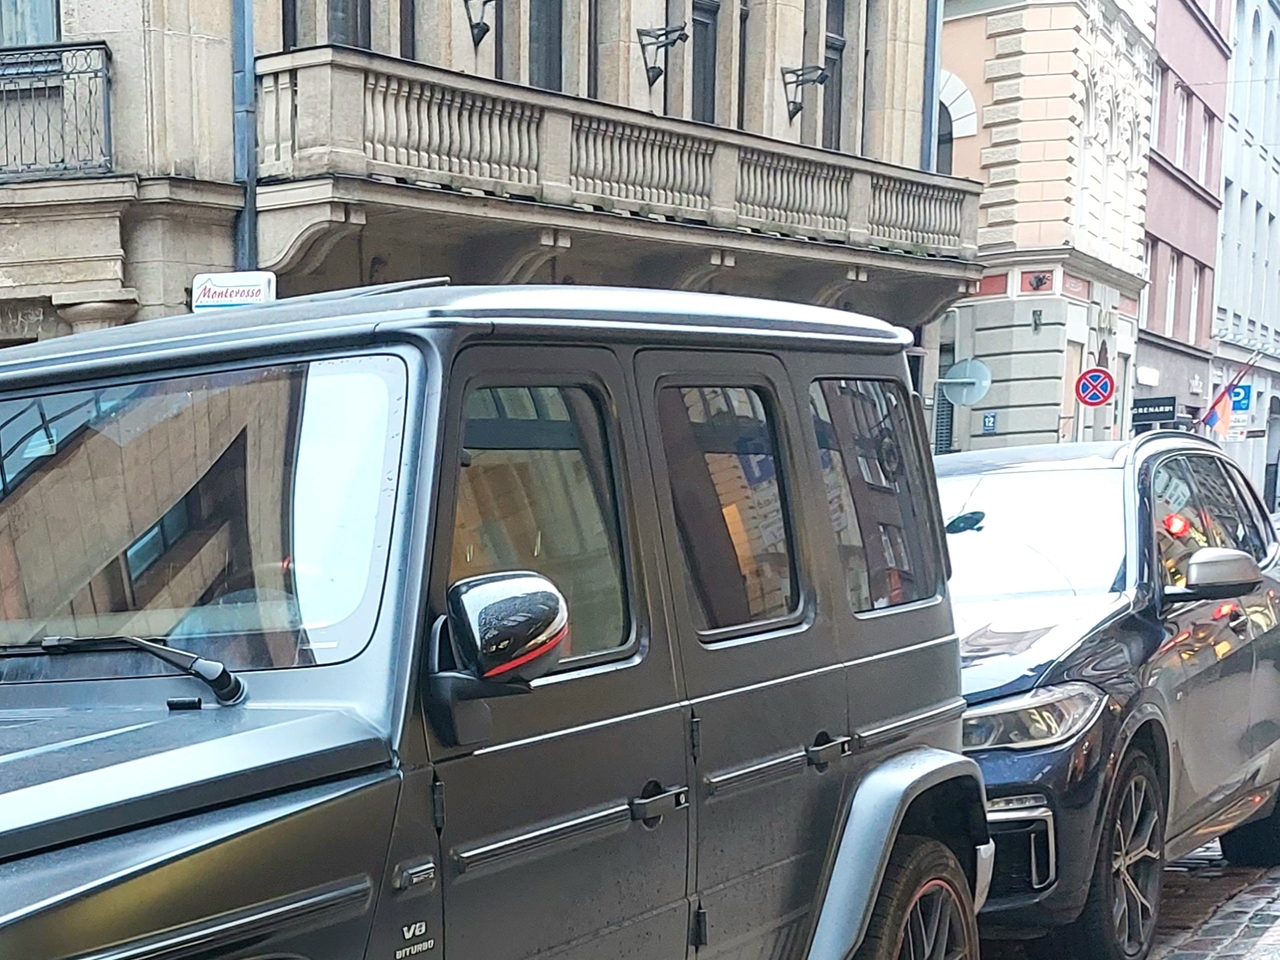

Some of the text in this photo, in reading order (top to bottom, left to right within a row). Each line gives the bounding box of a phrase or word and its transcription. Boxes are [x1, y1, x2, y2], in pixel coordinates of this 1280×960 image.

[195, 286, 261, 303] Monterosso
[985, 417, 994, 426] 12
[402, 921, 426, 940] V8
[395, 939, 434, 960] BITURBO
